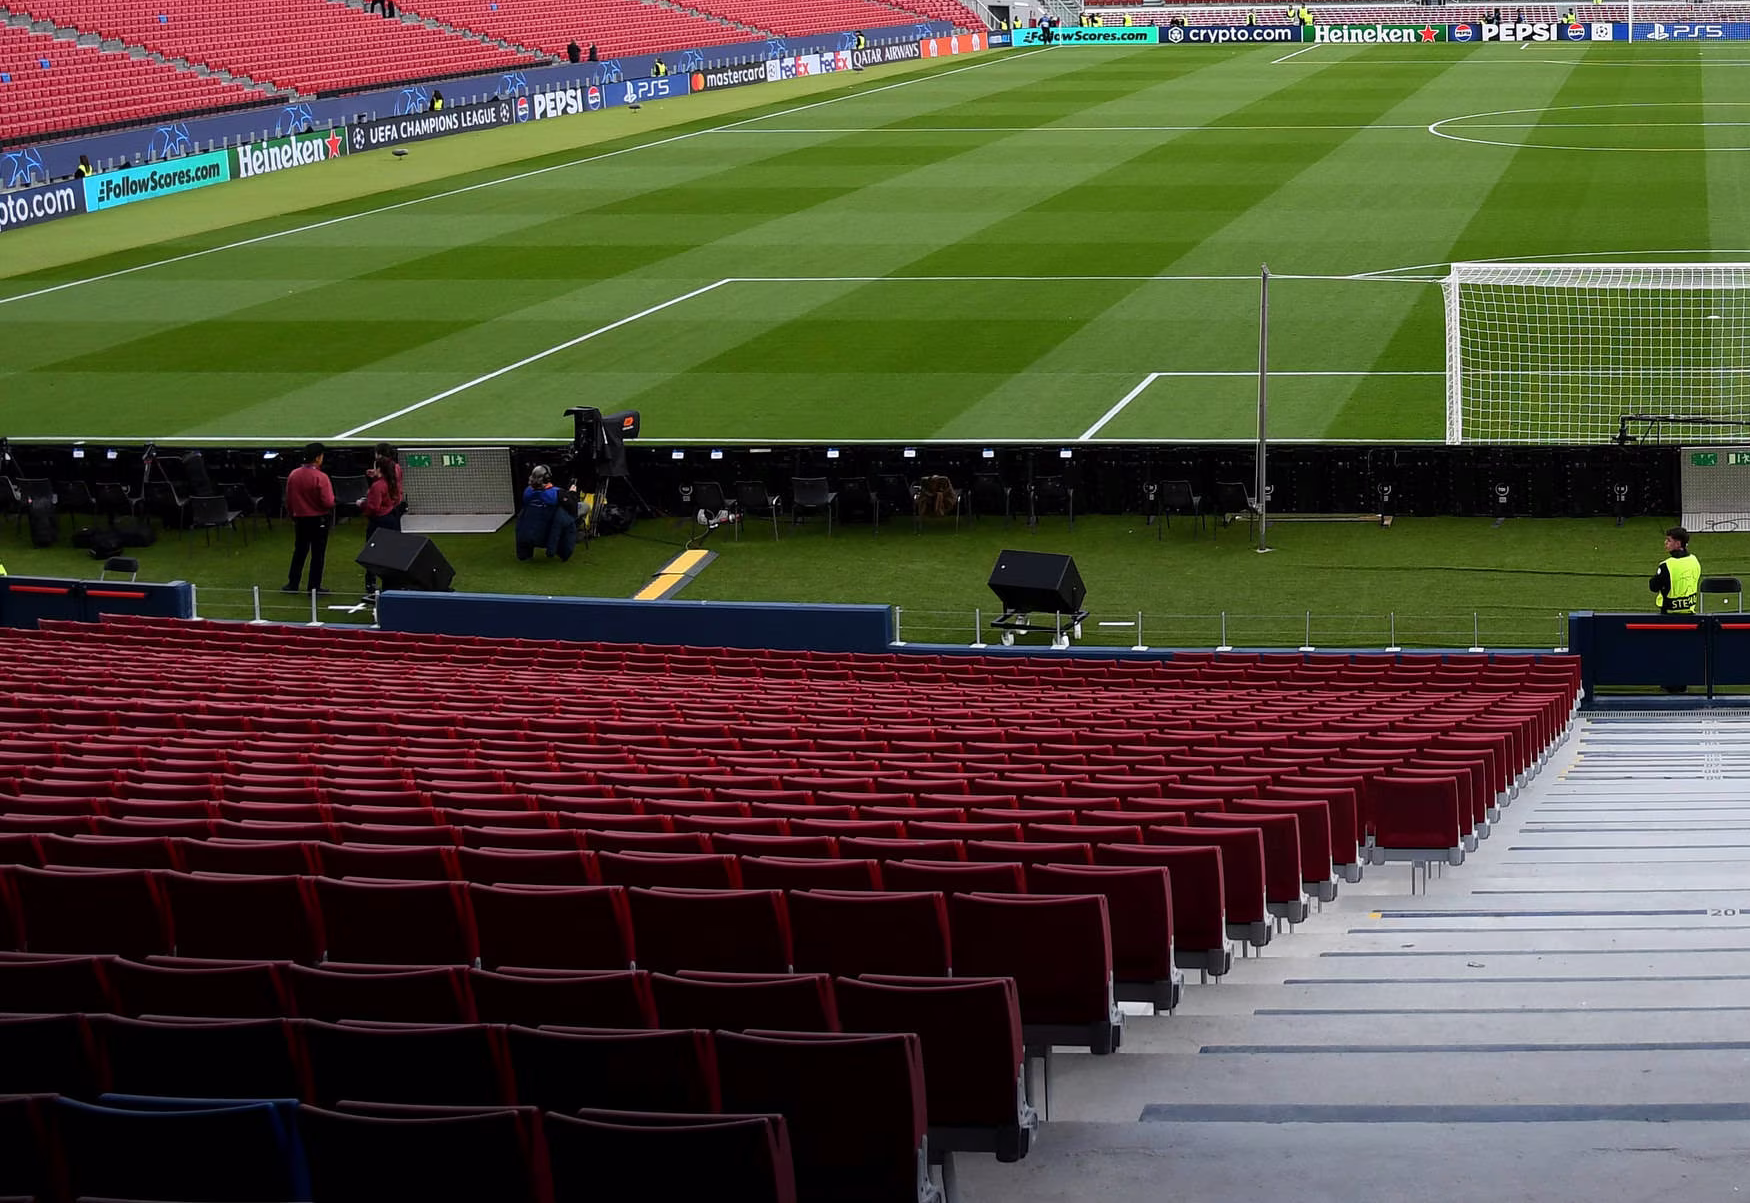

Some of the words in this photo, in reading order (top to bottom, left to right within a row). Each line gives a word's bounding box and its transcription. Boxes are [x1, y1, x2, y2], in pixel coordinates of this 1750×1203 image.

[1188, 27, 1292, 44] crypto.com
[1315, 24, 1416, 43] Heineken
[1482, 23, 1558, 42] PEPSI
[1673, 25, 1723, 39] PS5
[820, 53, 849, 72] FedEx
[853, 47, 883, 68] QATAR
[883, 42, 920, 63] AIRWAYS
[706, 64, 766, 88] mastercard
[780, 56, 810, 78] FedEx
[638, 79, 670, 98] PS5
[533, 88, 583, 120] PEPSI
[370, 124, 399, 144] UEFA
[400, 113, 459, 138] CHAMPIONS
[461, 107, 497, 127] LEAGUE
[236, 134, 326, 179] Heineken
[105, 163, 221, 202] FollowScores.com
[1710, 908, 1736, 917] 20
